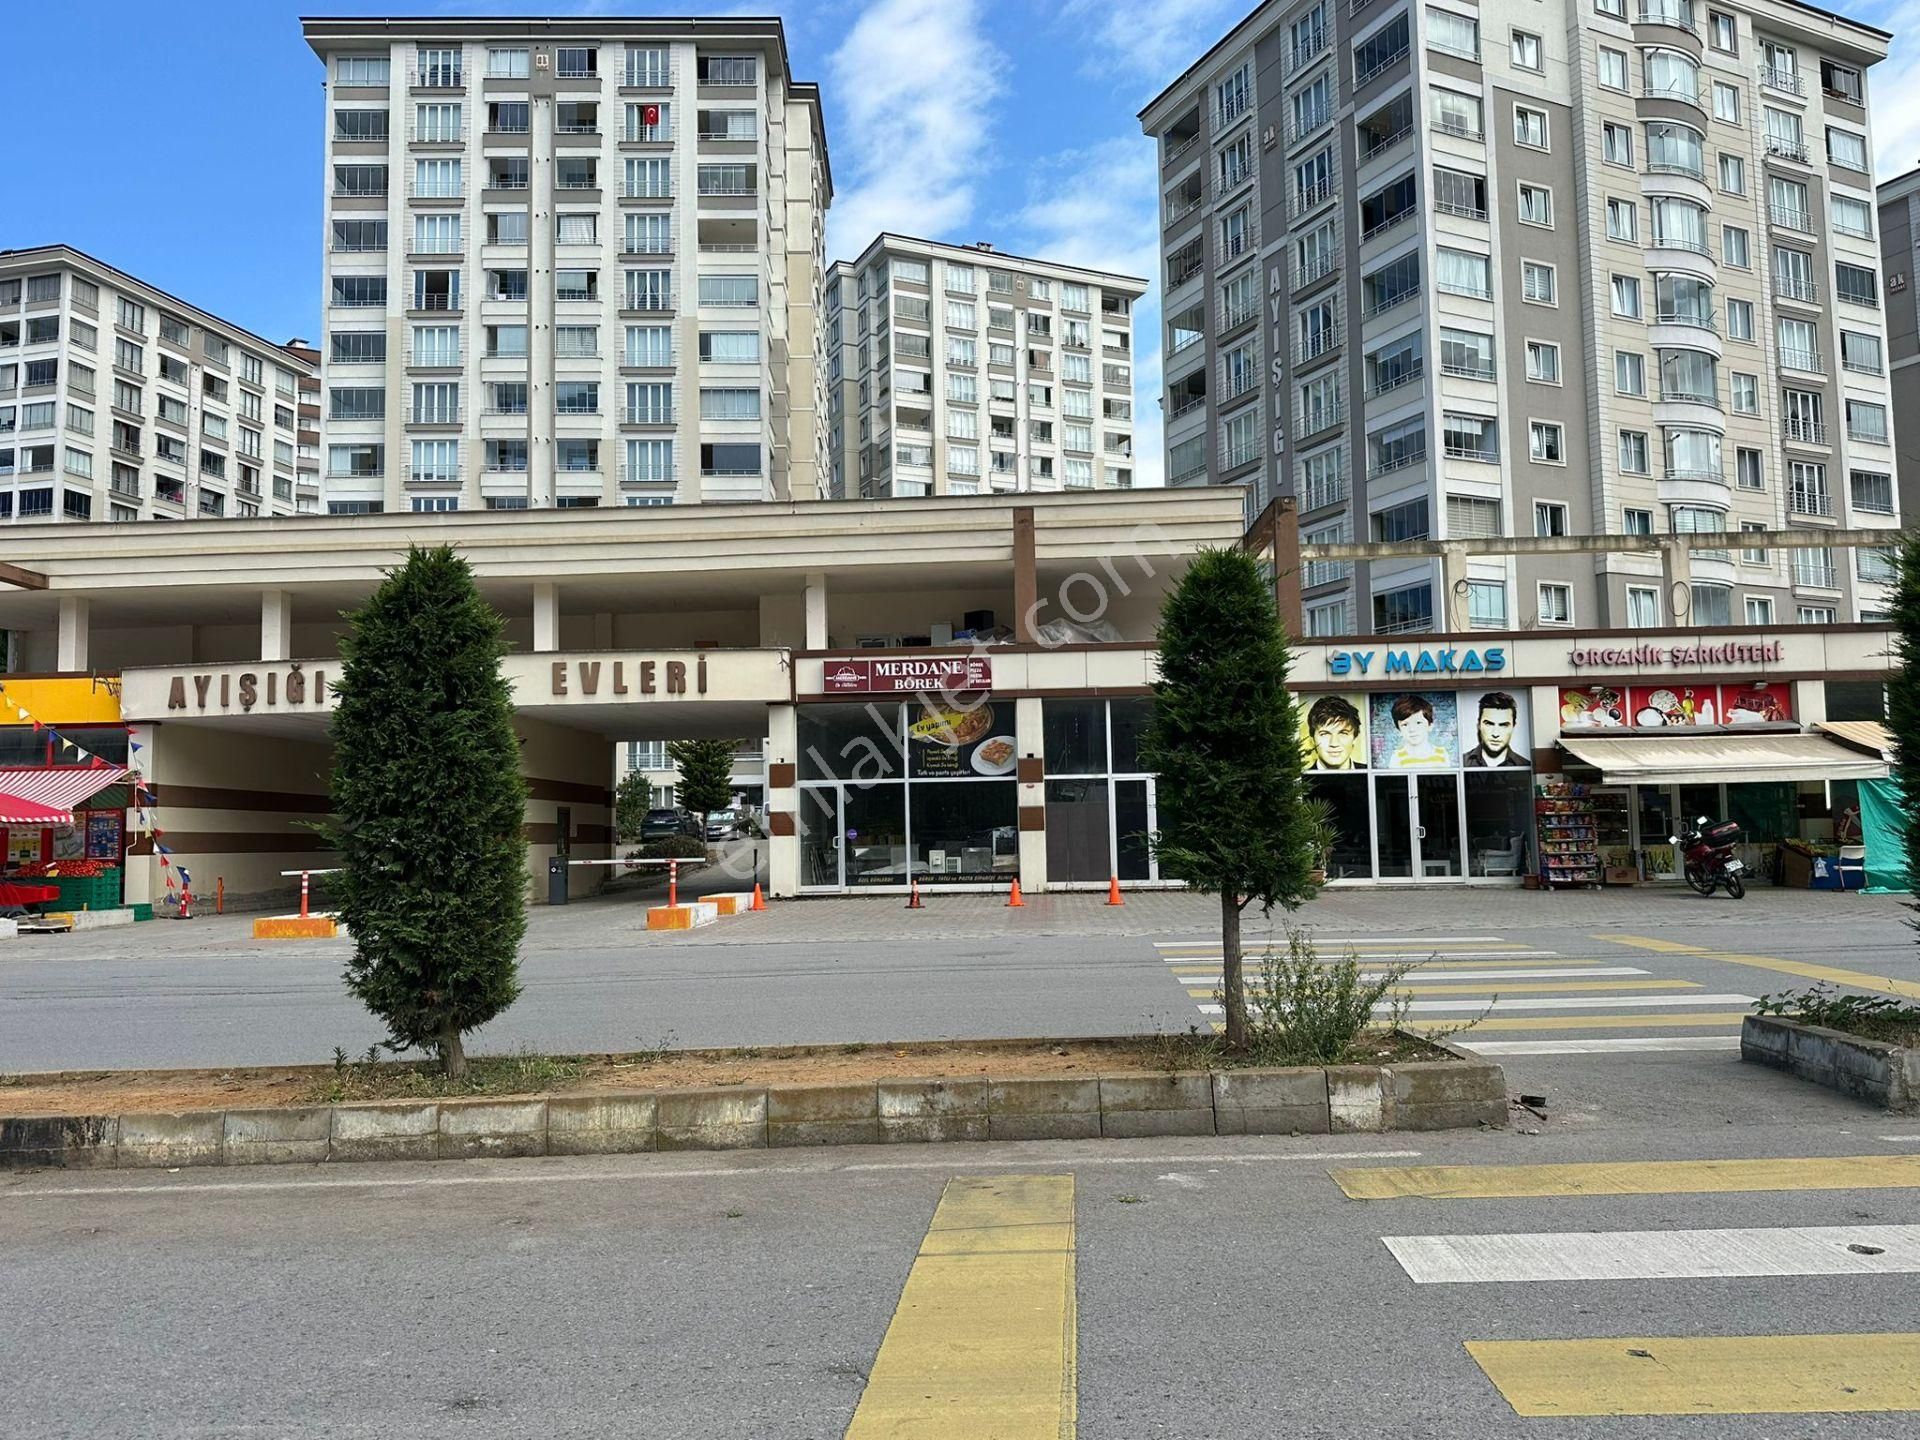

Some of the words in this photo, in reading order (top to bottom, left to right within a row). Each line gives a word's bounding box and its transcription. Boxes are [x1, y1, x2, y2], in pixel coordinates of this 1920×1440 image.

[1268, 266, 1284, 485] AYIŞIĞI
[1331, 650, 1375, 675] BY
[1385, 648, 1506, 674] MAKAS
[1571, 644, 1663, 667] ORGANİK
[1671, 640, 1782, 667] ŞARKÜTERİ
[875, 660, 964, 677] MERDANE
[168, 663, 324, 712] AYIŞIĞI
[552, 656, 708, 695] EVLERİ
[894, 676, 944, 690] BÖREK
